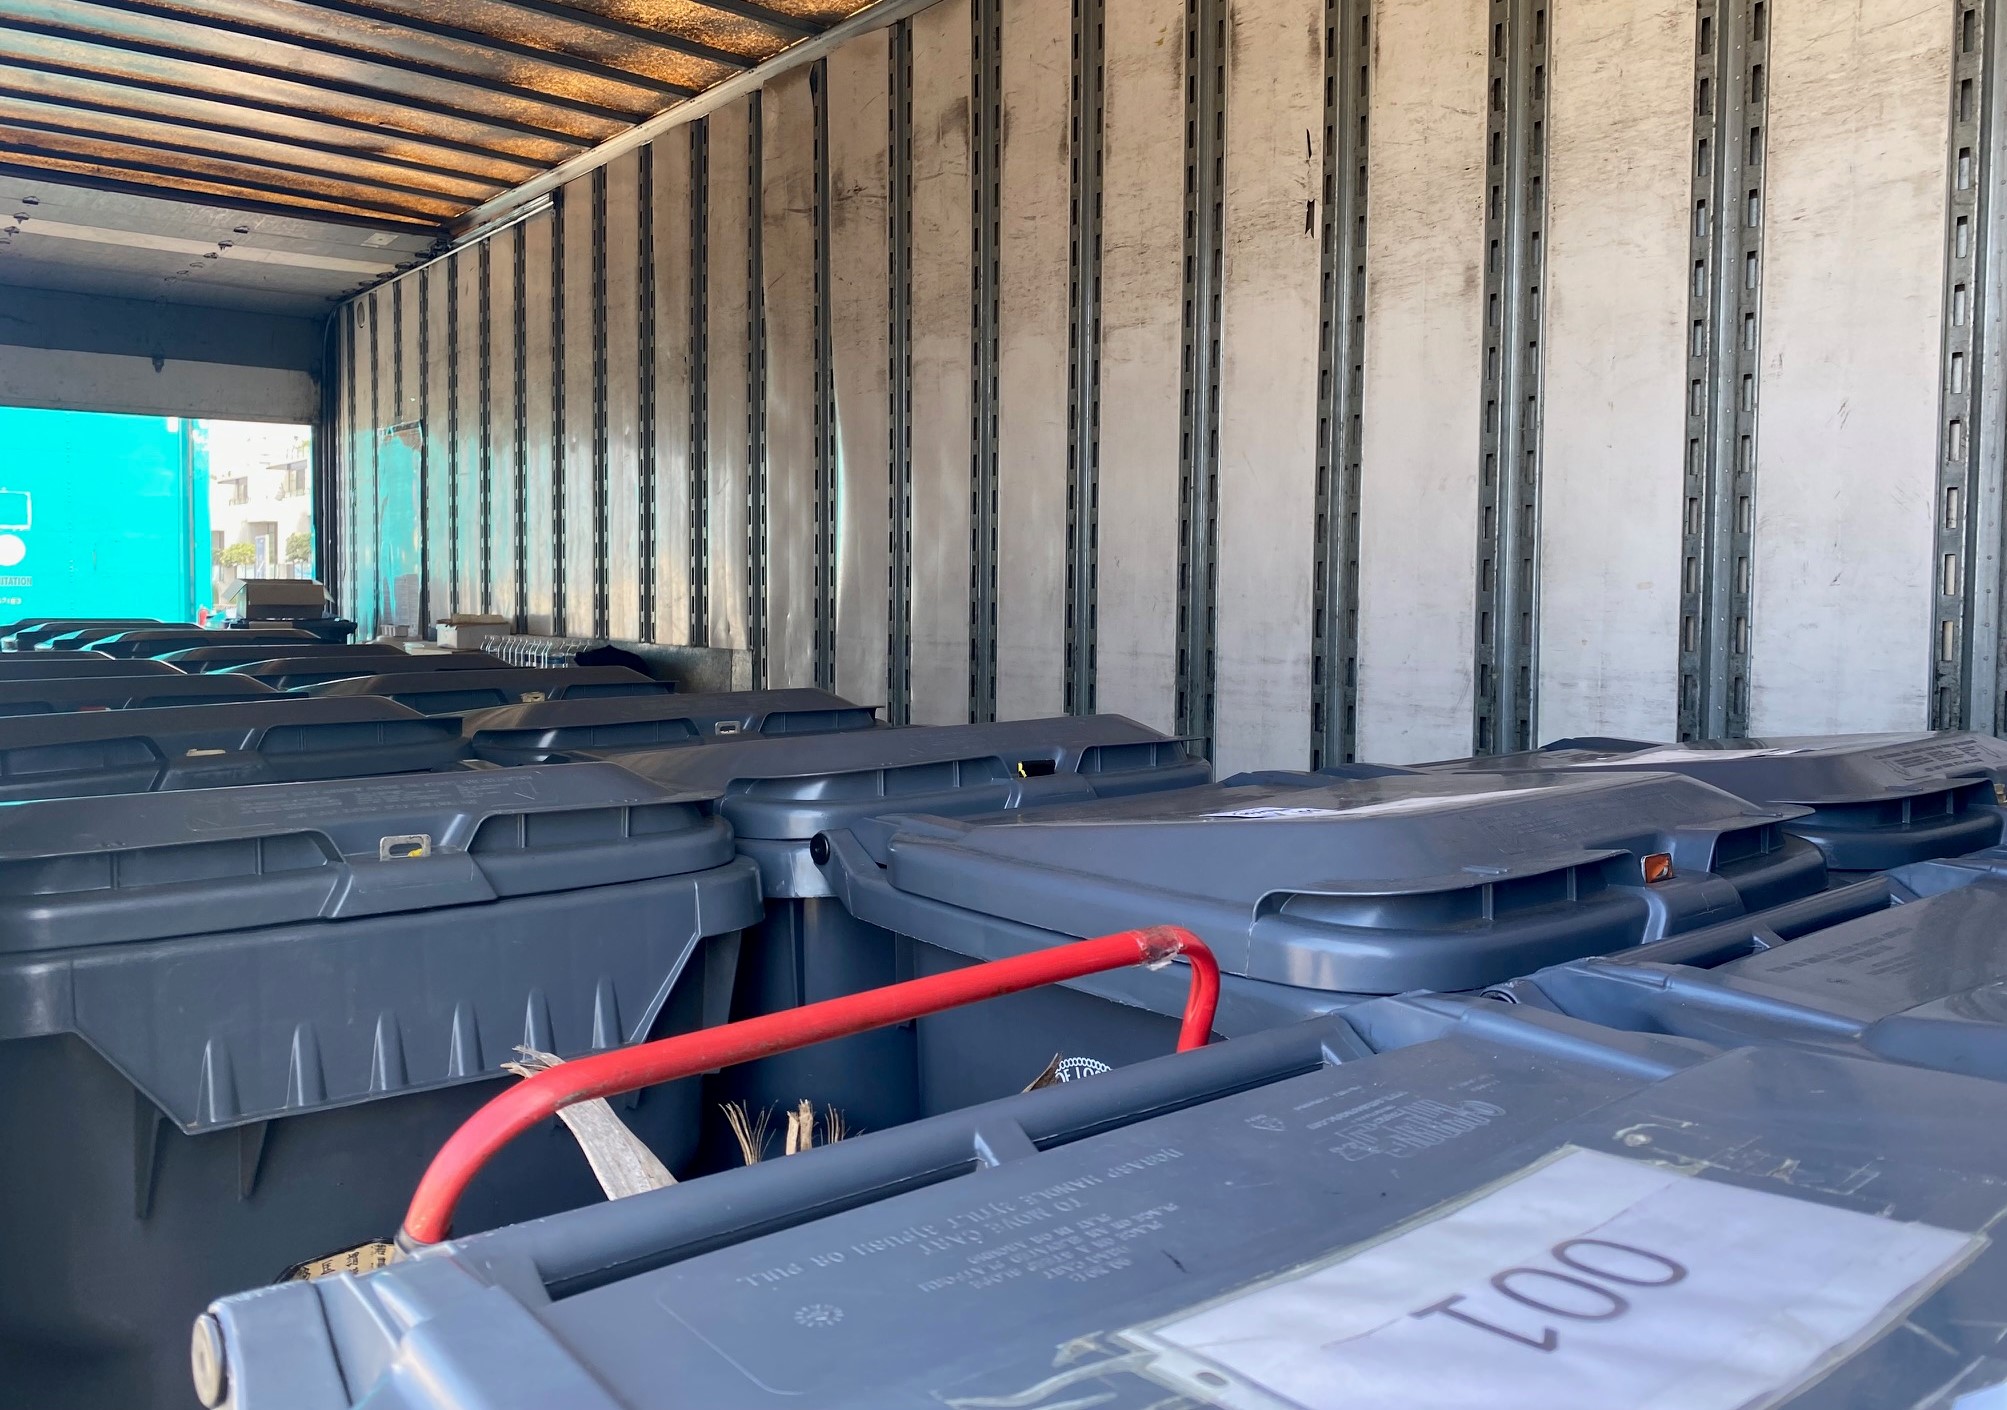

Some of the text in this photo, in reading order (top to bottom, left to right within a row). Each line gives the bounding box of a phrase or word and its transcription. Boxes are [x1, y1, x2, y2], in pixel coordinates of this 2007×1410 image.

[1018, 1174, 1104, 1207] HANDLE
[917, 1197, 1089, 1256] TO MOVE CART
[809, 1251, 846, 1268] OR
[917, 1259, 1006, 1293] PLATFORM
[1409, 1237, 1688, 1353] 001
